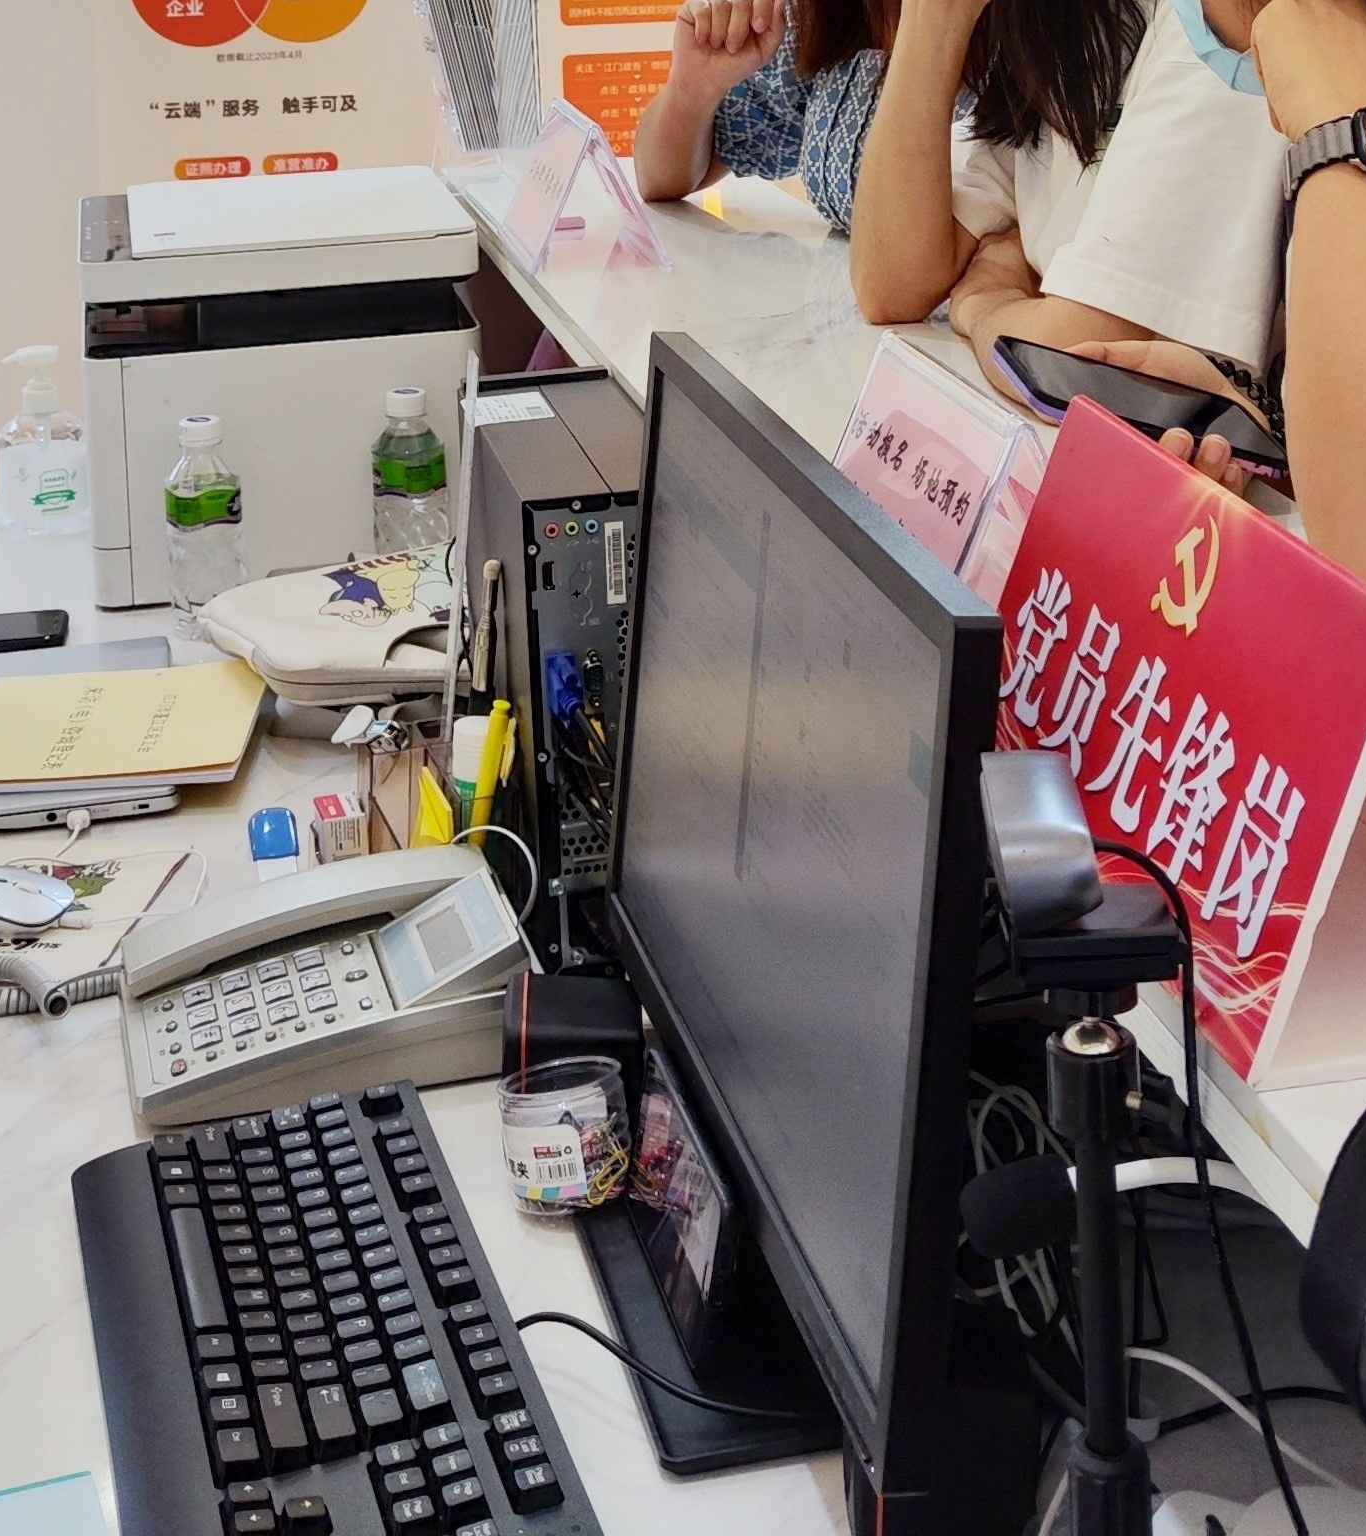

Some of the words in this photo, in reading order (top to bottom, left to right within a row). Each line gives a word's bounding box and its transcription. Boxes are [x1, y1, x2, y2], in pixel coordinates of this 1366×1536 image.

[216, 50, 303, 63] 数据截止2023年4月
[149, 98, 260, 119] “云端”服务
[282, 95, 357, 115] 触手可及
[851, 409, 908, 472] 活动报名
[911, 456, 971, 526] 场地预约
[1000, 566, 1306, 958] 党员先锋岗
